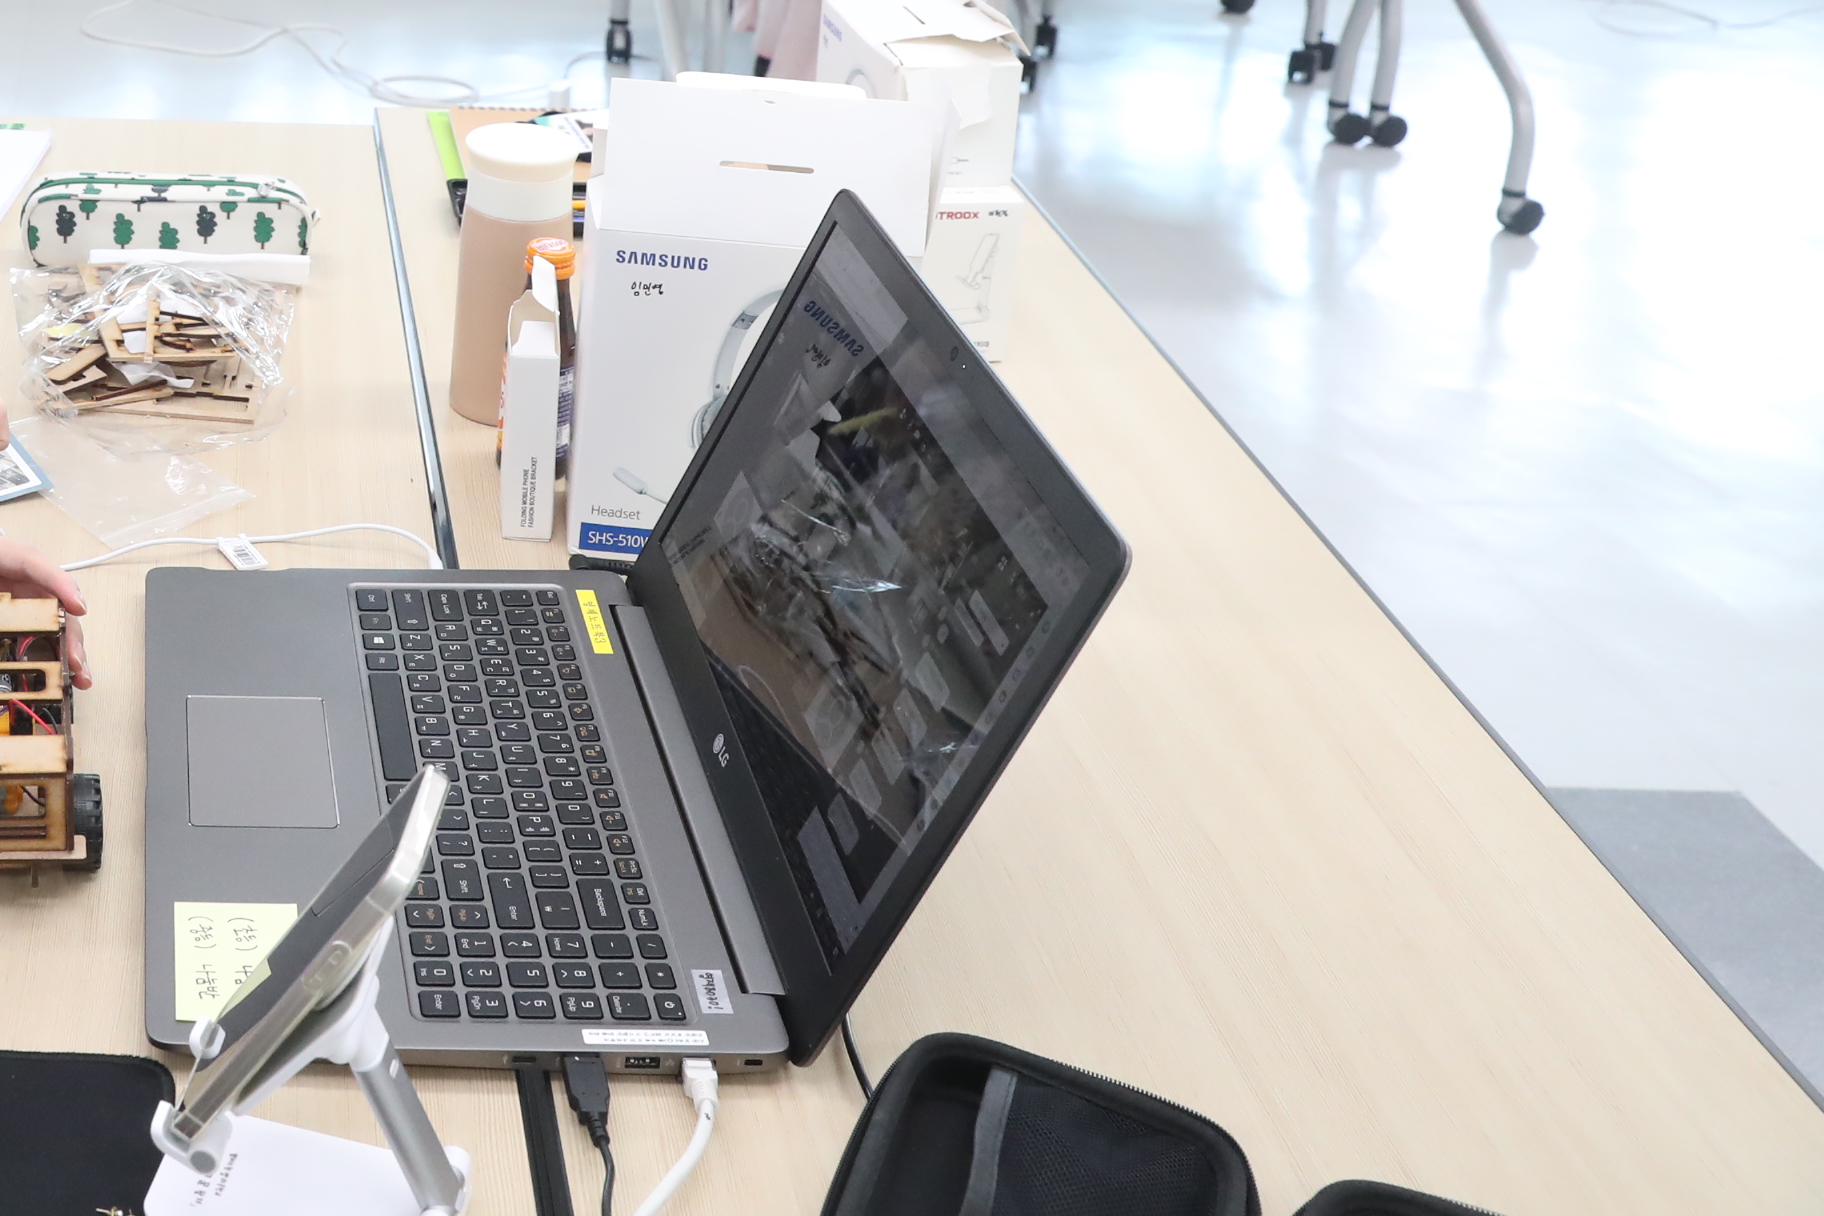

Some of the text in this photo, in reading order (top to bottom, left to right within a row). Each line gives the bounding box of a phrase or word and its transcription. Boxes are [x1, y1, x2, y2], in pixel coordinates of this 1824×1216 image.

[936, 211, 980, 221] TROOX
[616, 250, 708, 271] SAMSUNG
[530, 456, 538, 480] BRACKET
[520, 468, 530, 528] FOLDING MOBILE PHONE
[591, 505, 641, 520] Headset
[718, 746, 730, 768] LG
[460, 880, 468, 893] Shift
[594, 889, 606, 916] Backspace
[509, 906, 517, 920] Enter
[638, 910, 648, 926] NumLk
[434, 994, 442, 1009] Enter
[567, 997, 576, 1011] PgUp
[613, 996, 622, 1013] Delete
